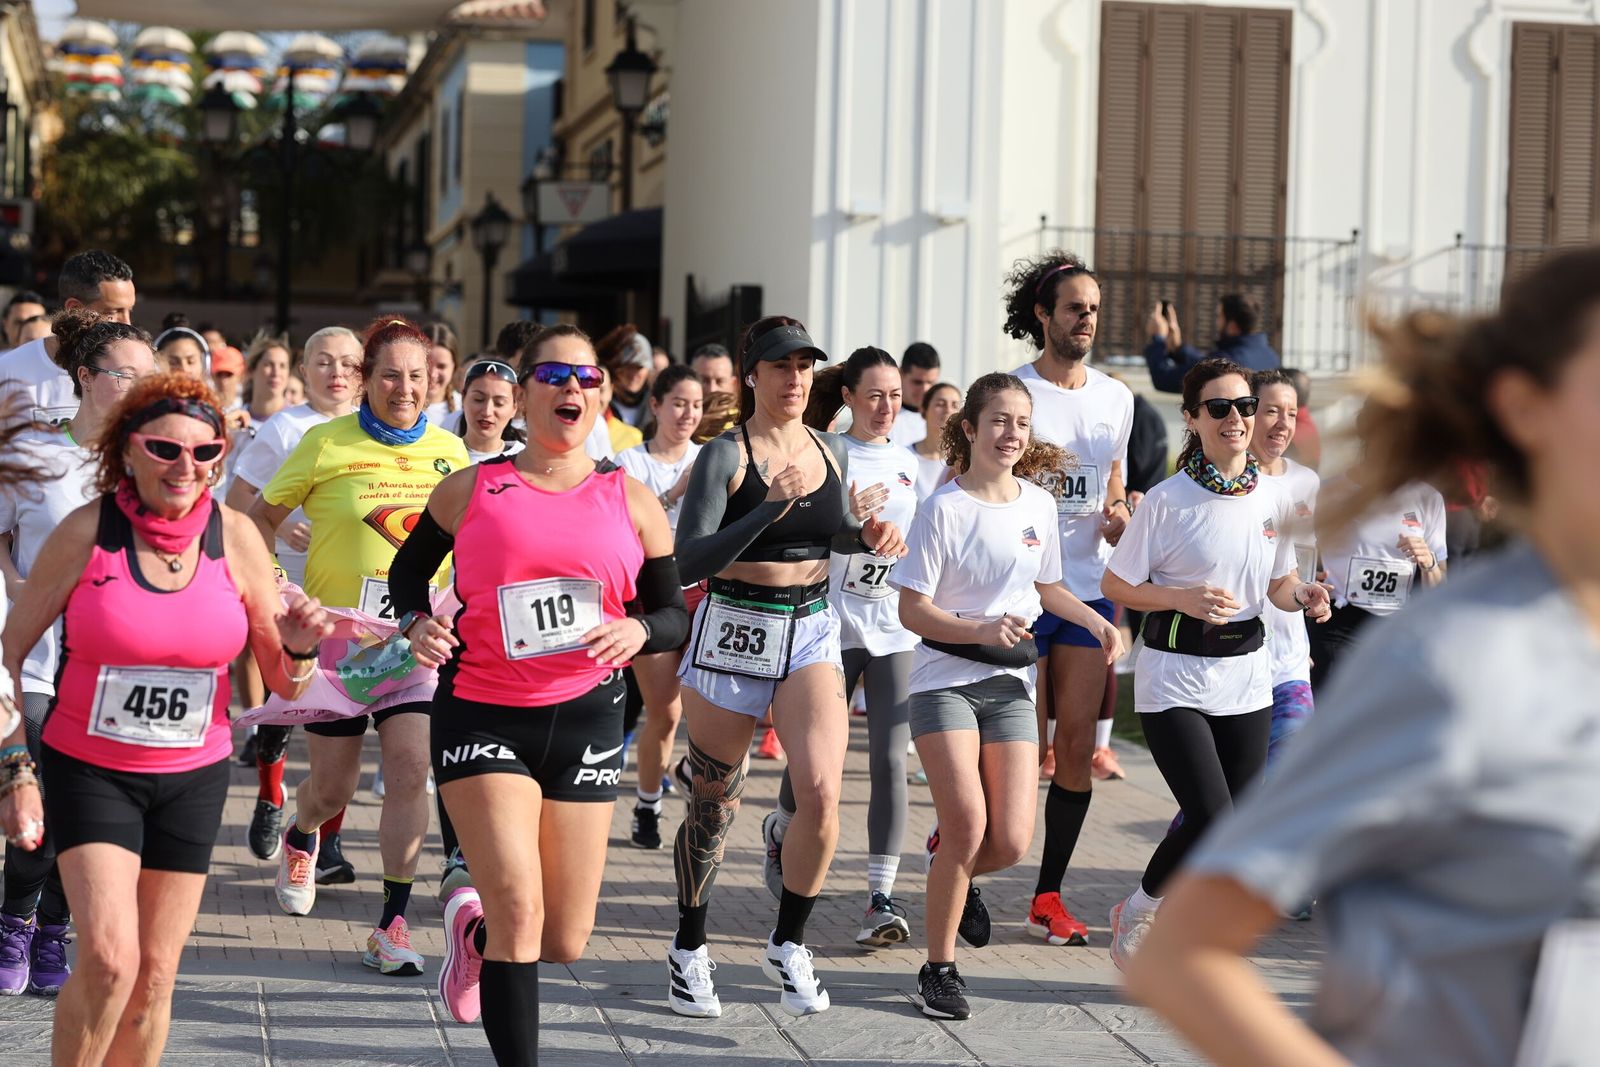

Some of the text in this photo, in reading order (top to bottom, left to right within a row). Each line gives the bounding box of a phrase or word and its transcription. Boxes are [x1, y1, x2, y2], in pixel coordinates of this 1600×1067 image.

[358, 491, 390, 500] contra
[405, 490, 430, 498] cánce
[377, 481, 414, 489] Marcha
[1057, 475, 1088, 499] 04
[1361, 569, 1399, 593] 325
[530, 593, 576, 632] 119
[717, 621, 767, 656] 253
[123, 684, 189, 722] 456
[442, 743, 517, 767] NIKE
[573, 768, 622, 786] PRO
